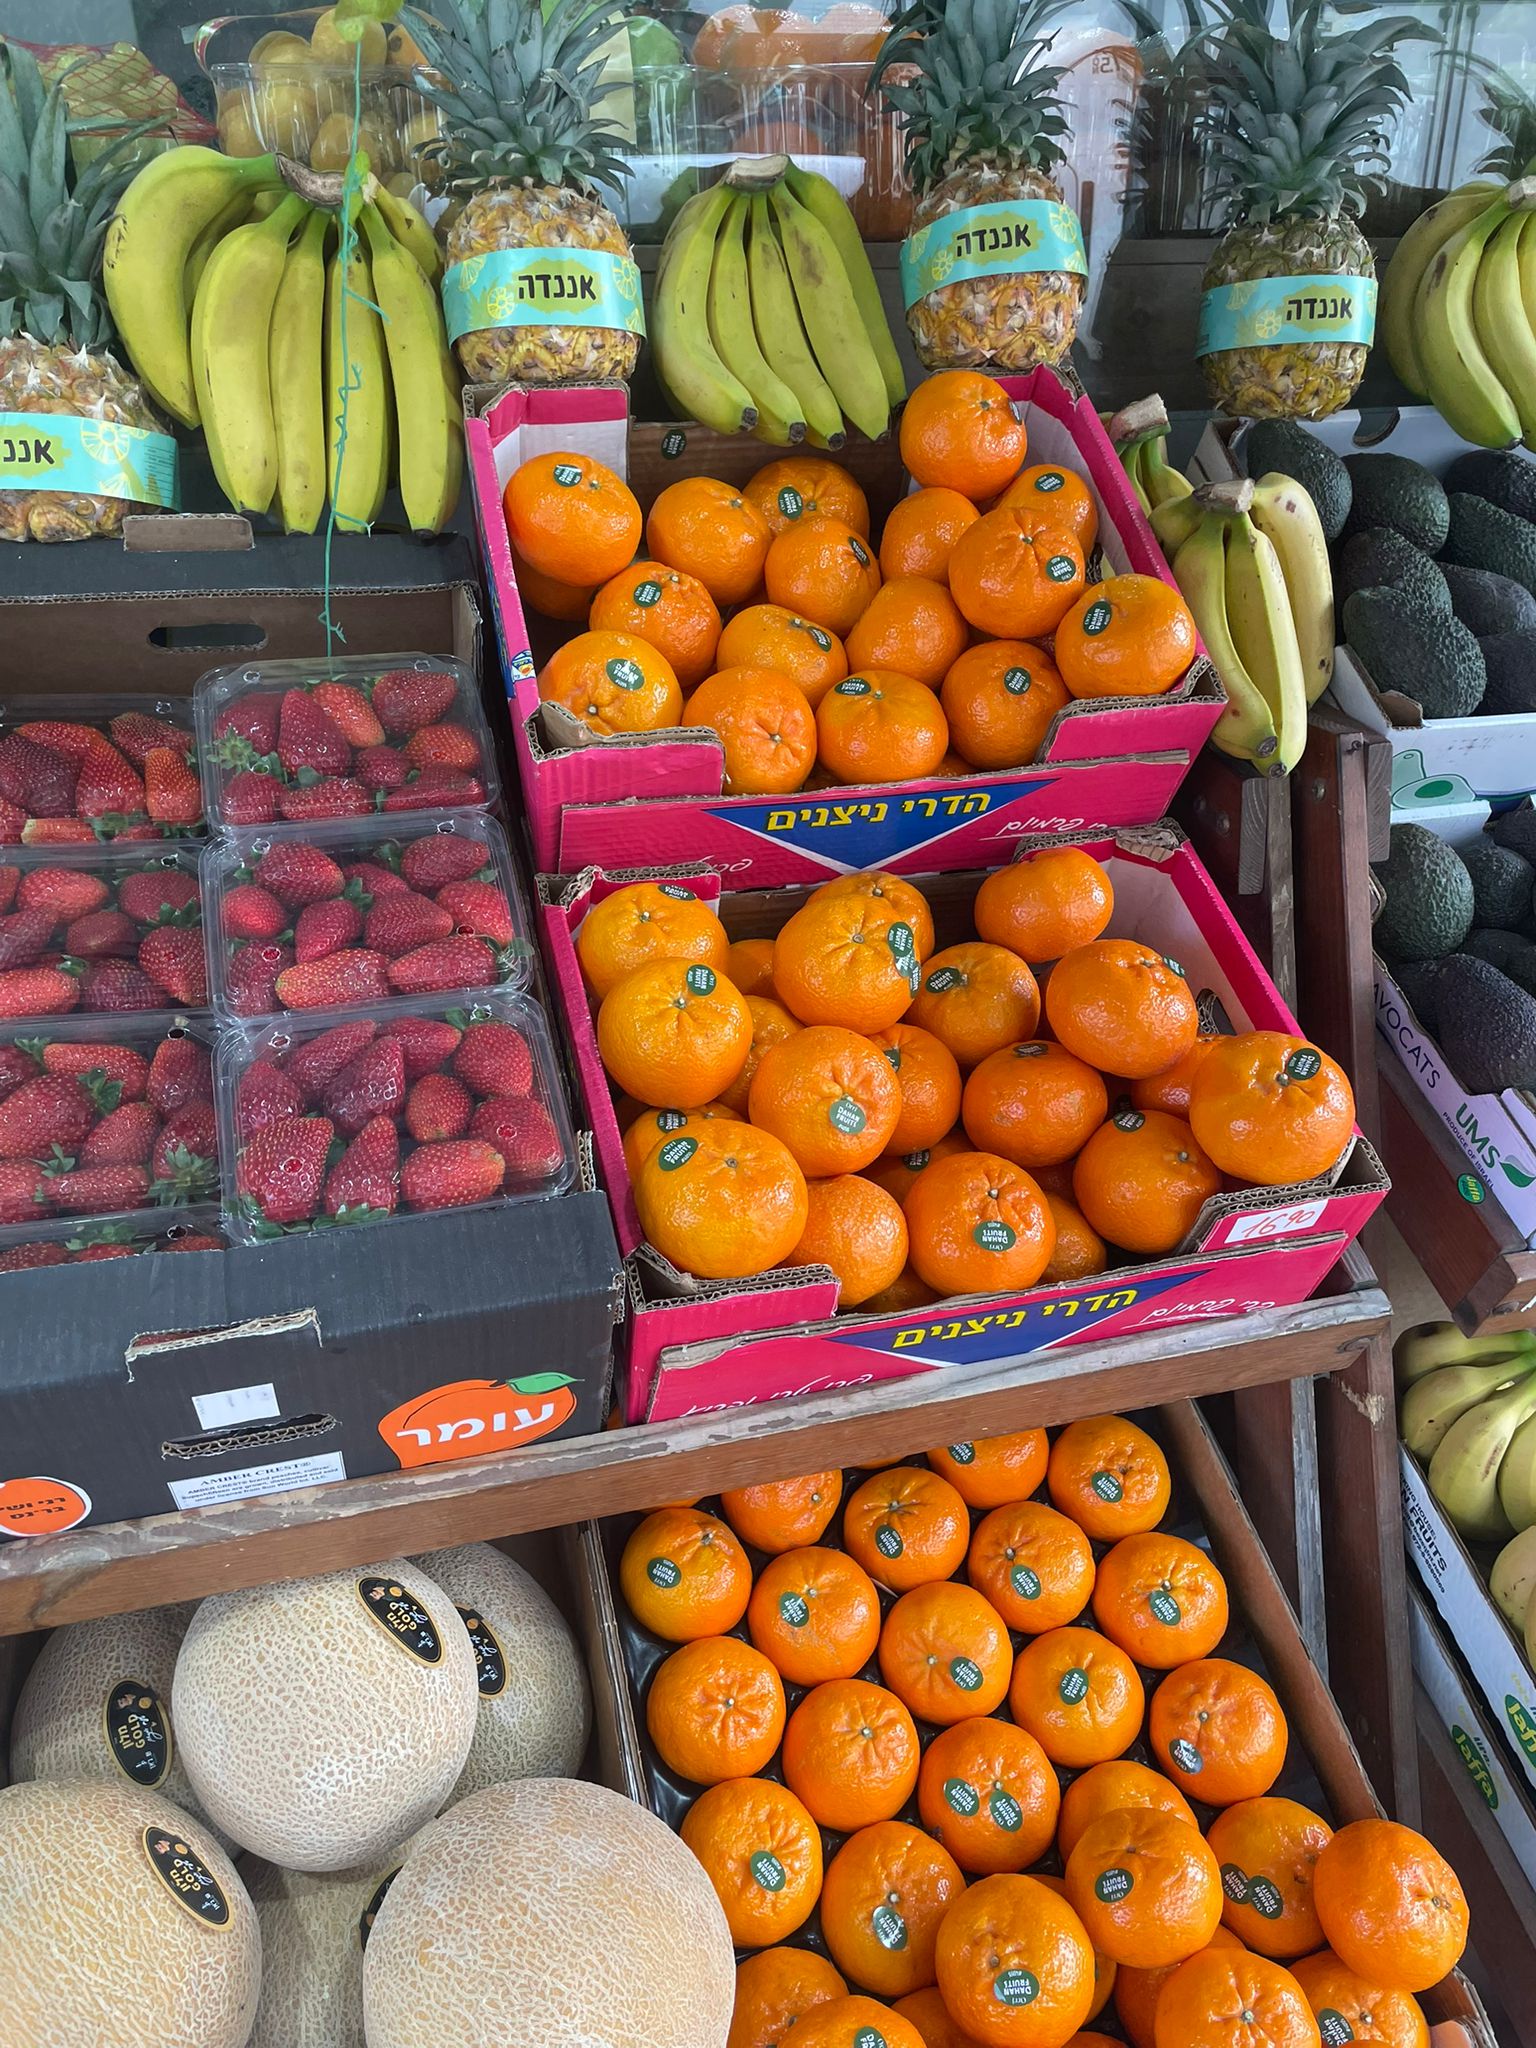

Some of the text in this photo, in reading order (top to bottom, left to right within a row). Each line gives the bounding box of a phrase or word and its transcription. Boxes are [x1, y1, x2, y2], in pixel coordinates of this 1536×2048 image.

[956, 224, 1031, 257] אננדה
[518, 274, 597, 300] אננדה
[1286, 297, 1353, 321] אננדה
[1089, 609, 1100, 630] DAHAN
[765, 793, 991, 832] הדרי ניצנים
[931, 972, 950, 986] DAHAN
[1302, 1056, 1315, 1075] DAHAN
[836, 1114, 858, 1128] FRUITS
[838, 1108, 860, 1122] DAHAN
[1456, 1103, 1501, 1169] UMS
[664, 1141, 688, 1162] DAHAN
[670, 1145, 691, 1164] FRUITS
[1443, 1111, 1495, 1189] PRODUCE OF ISRAEL
[982, 1236, 1008, 1244] DAHAN
[891, 1289, 1138, 1349] הדרי ניצנים
[396, 1403, 555, 1446] עומר
[200, 1472, 251, 1486] AMBER
[880, 1534, 894, 1554] DAHAN
[1410, 1505, 1448, 1572] FRUITS
[652, 1569, 674, 1583] DAHAN
[1016, 1574, 1032, 1595] DAHAN
[389, 1602, 417, 1631] GOLD
[1155, 1599, 1172, 1621] DAHAN
[386, 1612, 408, 1633] מלון
[955, 1668, 975, 1687] DAHAN
[1065, 1673, 1079, 1694] DAHAN
[1070, 1678, 1084, 1698] FRUITS
[117, 1725, 135, 1749] מלון
[128, 1714, 146, 1749] GOLD
[1455, 1733, 1493, 1798] Jaffa
[951, 1790, 971, 1811] DAHAN
[956, 1785, 975, 1806] FRUITS
[995, 1801, 1013, 1826] DAHAN
[1001, 1799, 1018, 1821] FRUITS
[169, 1869, 191, 1892] מלון
[173, 1859, 201, 1891] GOLD
[757, 1862, 776, 1886] DAHAN
[763, 1858, 780, 1881] FRUITS
[1103, 1875, 1127, 1886] FRUITS
[1103, 1881, 1128, 1894] DAHAN
[1225, 1874, 1244, 1899] DAHAN
[1229, 1871, 1247, 1894] FRUITS
[1254, 1887, 1273, 1913] DAHAN
[1260, 1885, 1277, 1907] FRUITS
[1004, 1979, 1029, 1988] FRUITS
[1004, 1986, 1031, 1995] DAHAN
